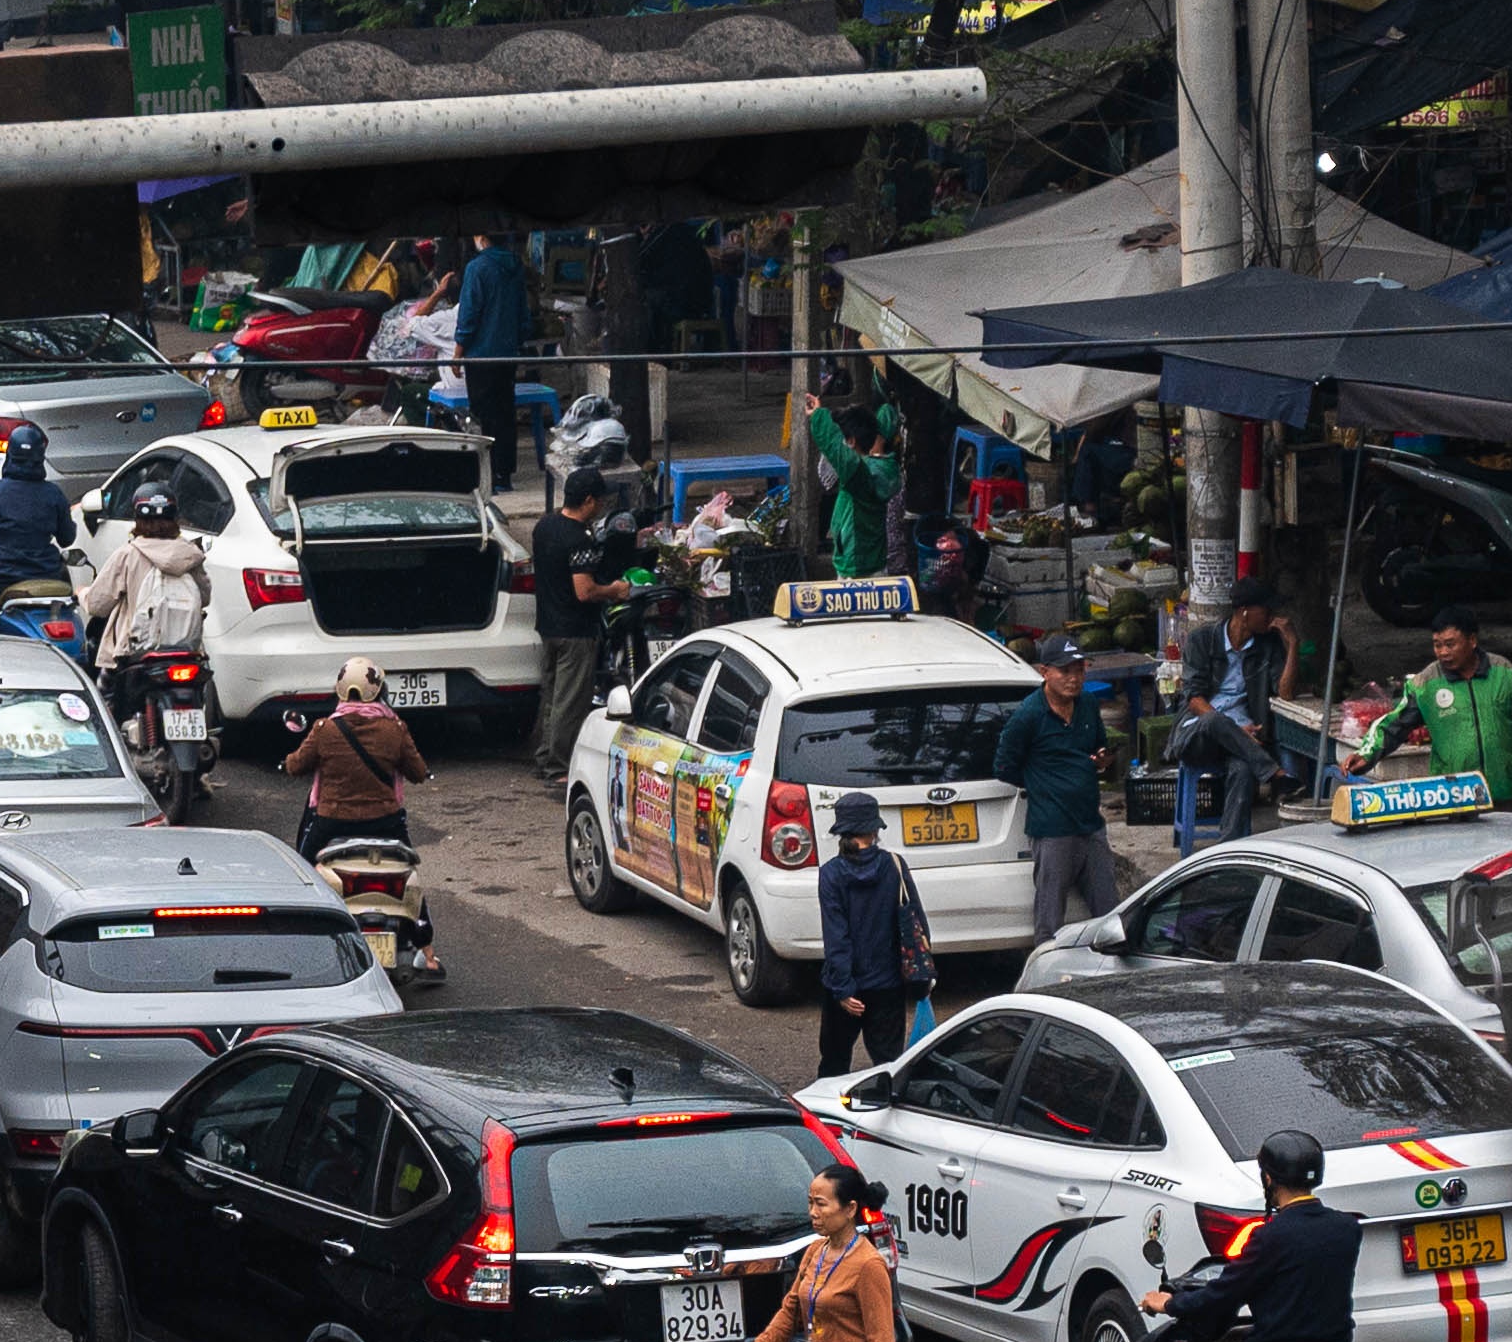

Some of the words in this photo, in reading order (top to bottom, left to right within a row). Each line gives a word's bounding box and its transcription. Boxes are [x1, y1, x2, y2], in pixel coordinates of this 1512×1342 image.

[150, 14, 206, 68] NHÀ
[273, 409, 310, 425] TAXI
[842, 580, 875, 589] TAXI
[825, 593, 852, 613] SAO
[854, 586, 879, 611] THỦ
[882, 586, 902, 610] ĐÔ
[399, 674, 429, 692] 30G
[388, 689, 440, 707] 797.85
[1384, 782, 1422, 812] THỦ
[1422, 783, 1450, 807] ĐÔ
[923, 804, 956, 823] 29A
[911, 823, 972, 844] 530.23
[1122, 1168, 1183, 1193] SPORT
[905, 1182, 969, 1241] 1990
[1438, 1218, 1480, 1242] 36H
[1425, 1240, 1497, 1269] 093.22
[681, 1283, 724, 1313] 30A
